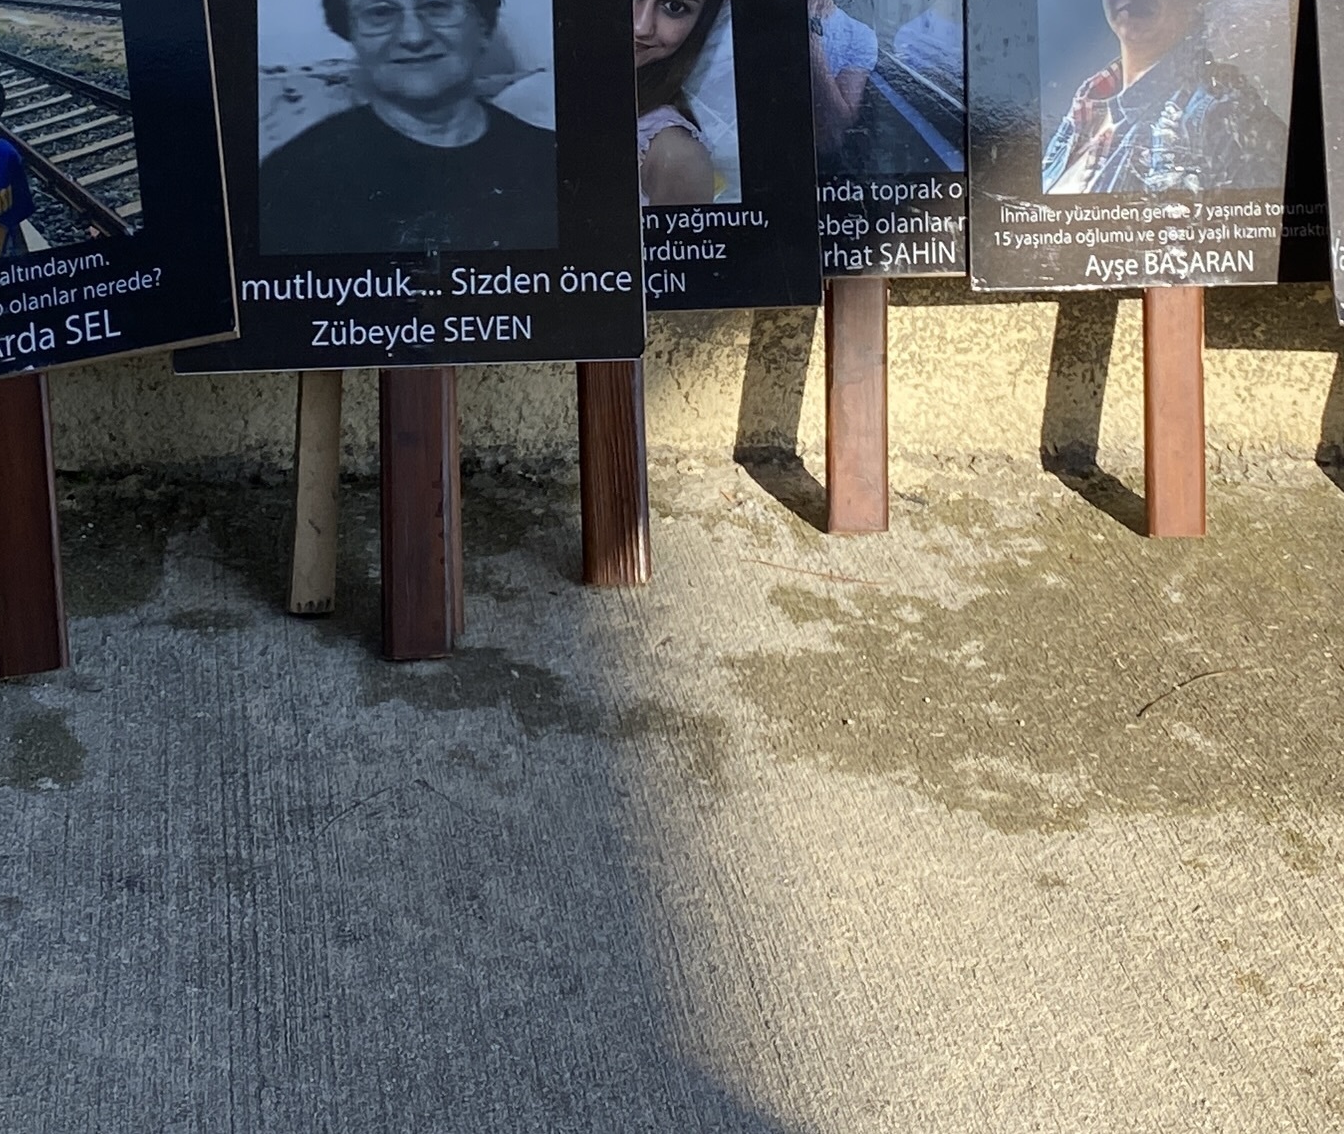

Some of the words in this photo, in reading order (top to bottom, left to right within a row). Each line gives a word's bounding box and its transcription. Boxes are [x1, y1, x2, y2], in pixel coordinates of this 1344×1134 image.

[817, 179, 864, 202] ında
[871, 177, 944, 205] toprak
[665, 207, 770, 234] yağmuru,
[876, 211, 953, 234] olanlar
[1065, 205, 1139, 224] yüzünden
[1194, 203, 1203, 218] 7
[1206, 201, 1262, 221] yaşında
[994, 231, 1012, 247] 15
[1015, 229, 1072, 249] yaşında
[1075, 227, 1134, 248] oğlumu
[1137, 230, 1155, 243] ve
[1234, 223, 1277, 239] kızımı
[0, 252, 111, 285] altındayım.
[824, 242, 873, 267] rhat
[879, 237, 956, 271] ŞAHİN
[1085, 254, 1138, 282] Ayşe
[1145, 249, 1254, 279] BAŞARAN
[8, 286, 77, 315] olanlar
[83, 268, 162, 303] nerede?
[451, 266, 551, 296] Sizden
[559, 266, 633, 294] önce
[646, 268, 686, 298] ÇİN
[65, 309, 122, 345] SEL
[311, 318, 436, 350] Zübeyde
[444, 315, 532, 342] SEVEN
